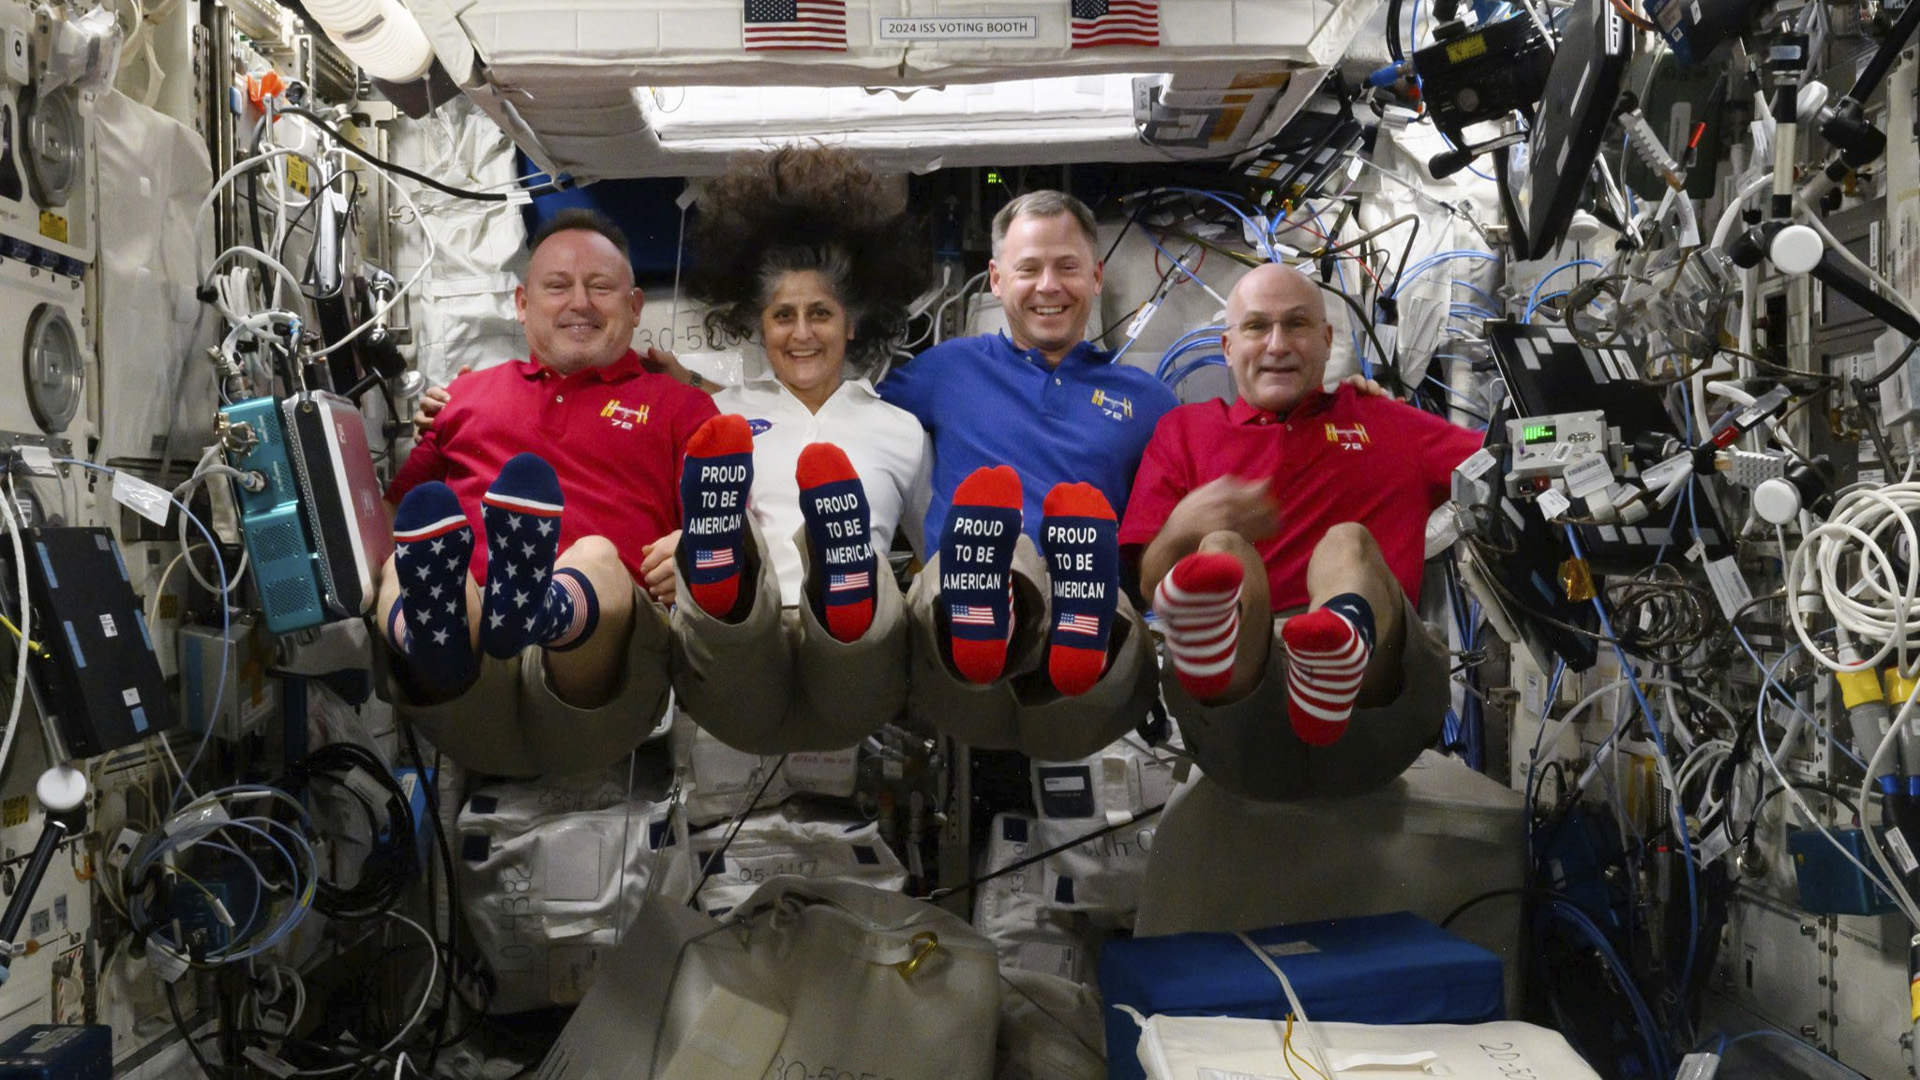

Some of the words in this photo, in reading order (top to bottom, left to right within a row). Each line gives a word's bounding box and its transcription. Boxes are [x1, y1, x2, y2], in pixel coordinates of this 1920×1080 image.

[889, 23, 916, 33] 2024
[920, 23, 936, 33] ISS
[939, 22, 983, 33] VOTING
[987, 22, 1027, 32] BOOTH
[1102, 408, 1122, 421] 72
[611, 418, 633, 431] 72
[1340, 443, 1363, 451] 72
[701, 465, 746, 483] PROUD
[701, 491, 717, 508] TO
[720, 491, 739, 508] BE
[815, 493, 858, 515] PROUD
[688, 513, 742, 535] AMERICAN
[825, 521, 842, 538] TO
[844, 518, 863, 537] BE
[953, 517, 1004, 536] PROUD
[1048, 526, 1097, 544] PROUD
[955, 544, 972, 562] TO
[976, 546, 995, 563] BE
[1055, 553, 1072, 570] TO
[1076, 553, 1094, 571] BE
[943, 573, 1001, 590] AMERICAN
[1054, 581, 1105, 599] AMERICAN
